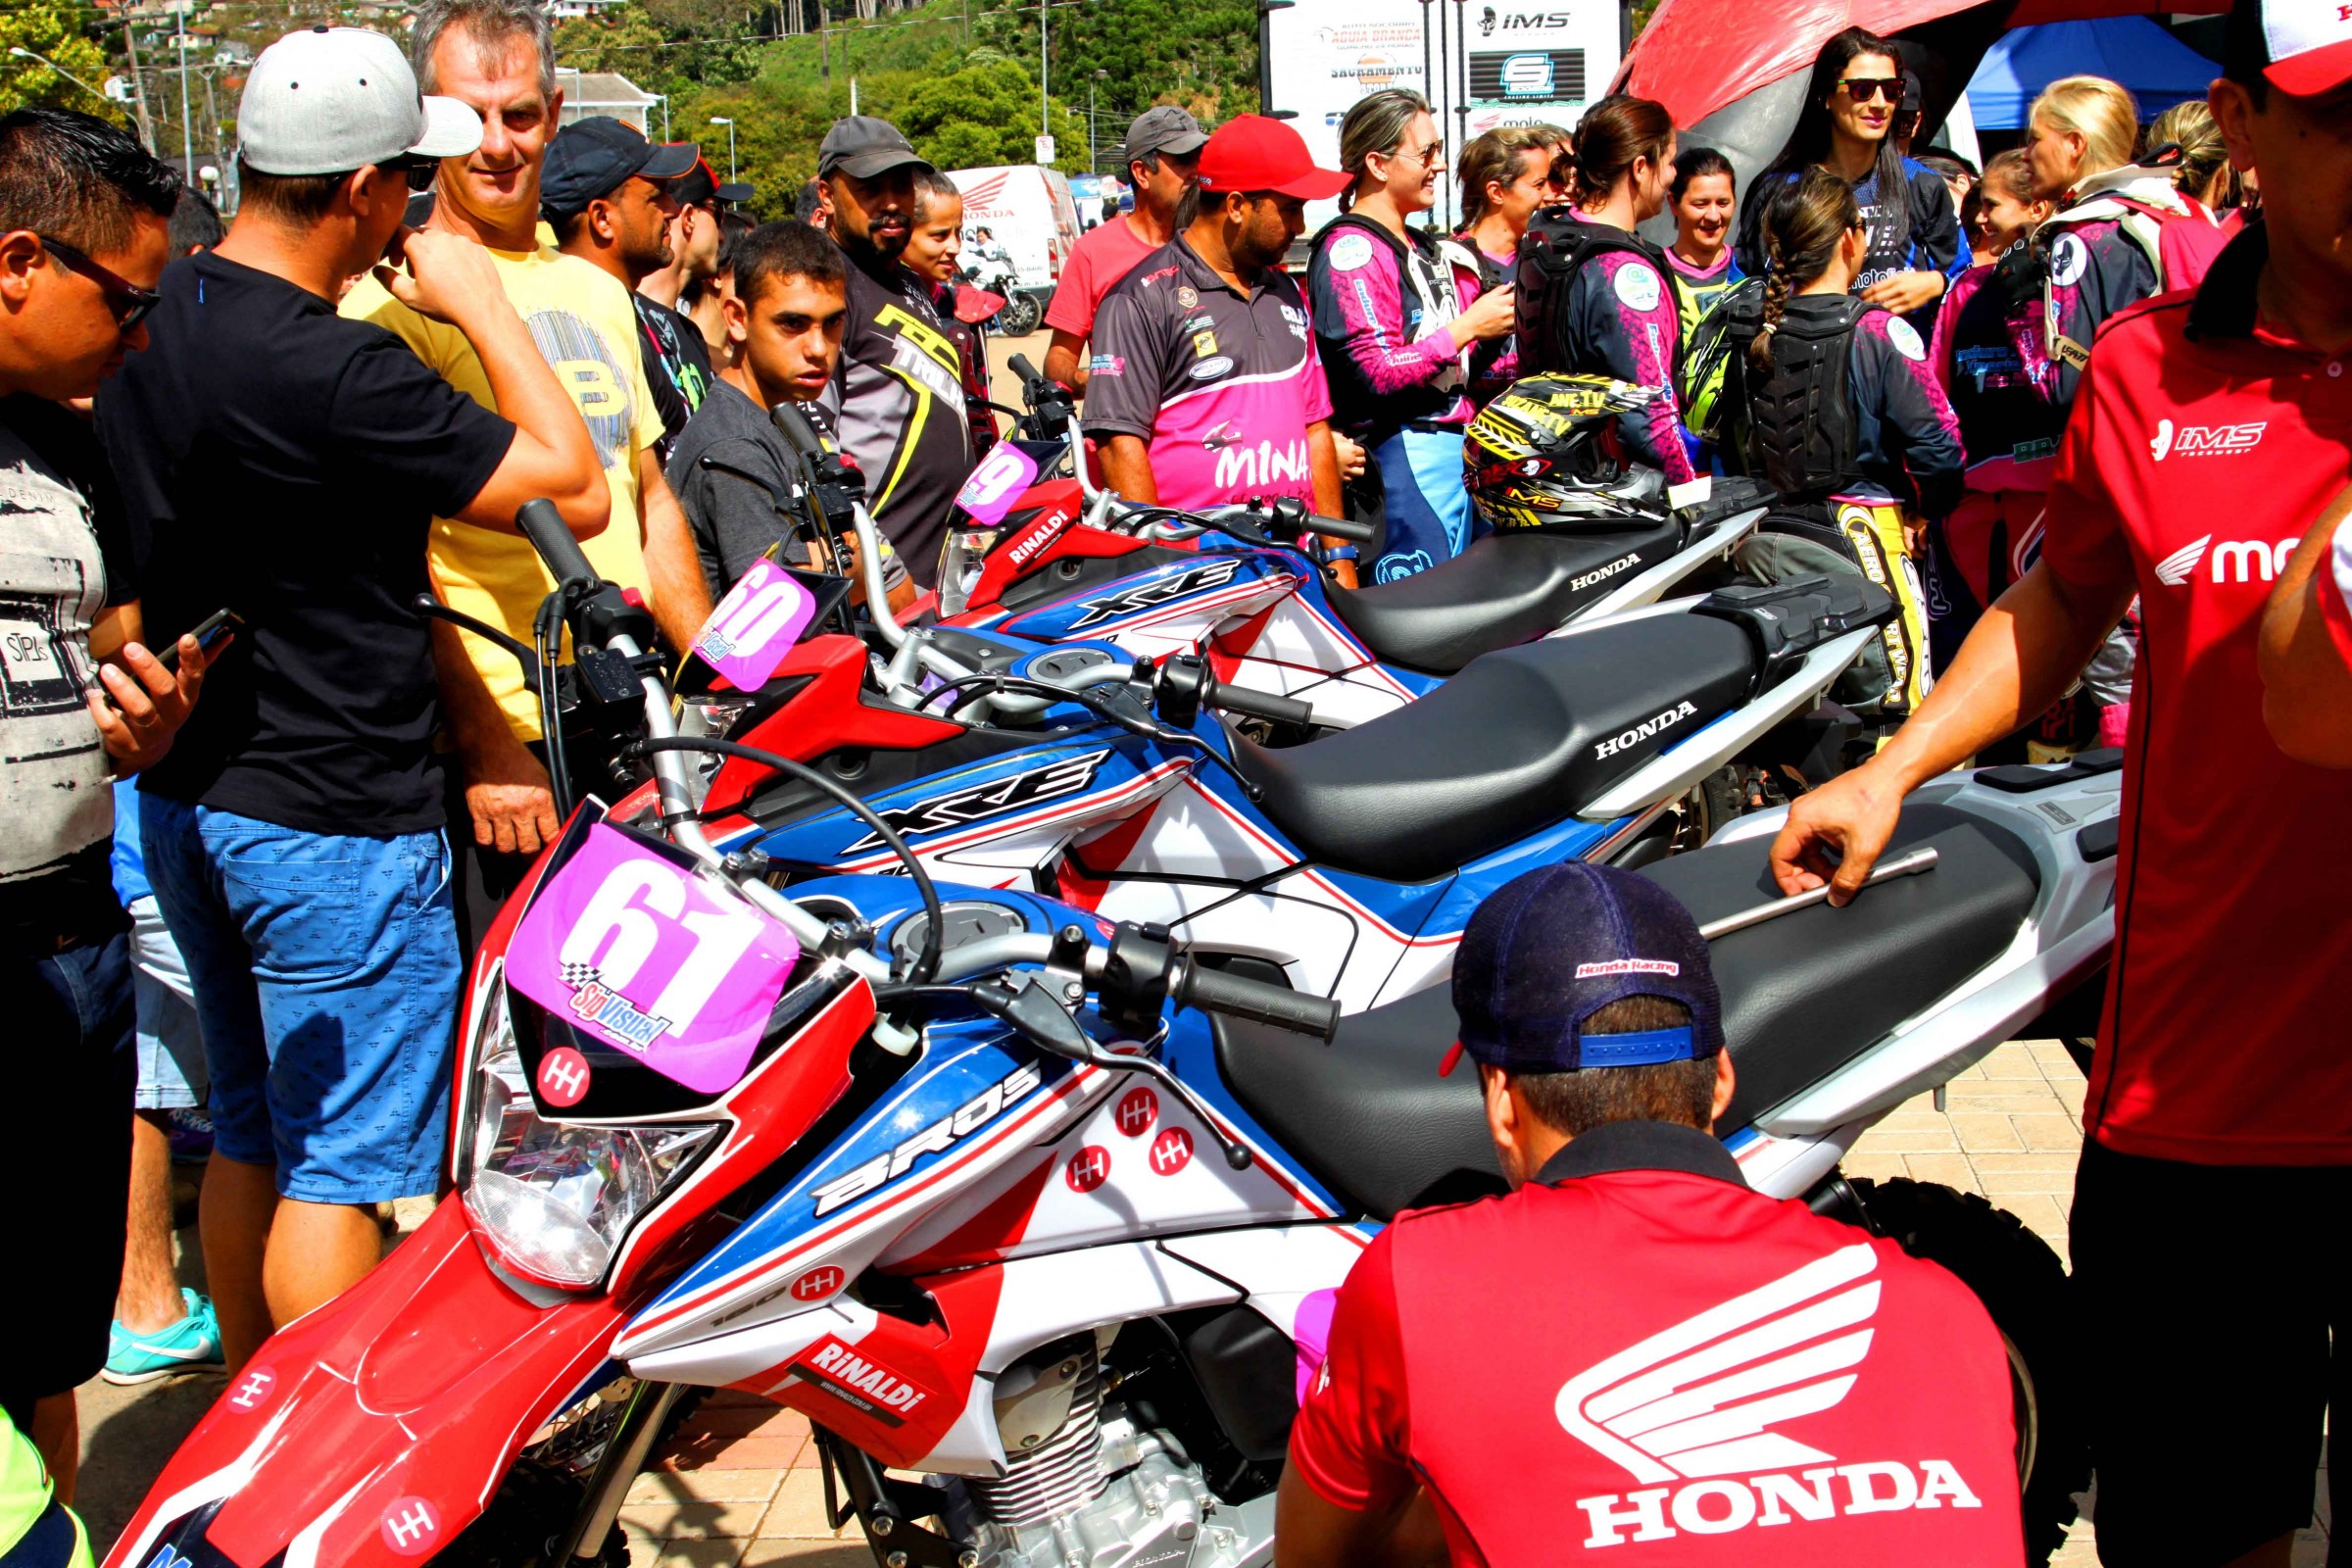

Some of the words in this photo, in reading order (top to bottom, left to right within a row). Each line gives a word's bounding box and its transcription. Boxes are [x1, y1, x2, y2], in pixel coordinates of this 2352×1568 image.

[1371, 28, 1421, 41] BRANCA
[1331, 66, 1422, 78] SACRAMENTO
[1215, 439, 1312, 489] MINA
[9, 488, 55, 504] DENIM
[1571, 553, 1642, 592] HONDA
[1849, 527, 1886, 584] AERO
[1594, 701, 1698, 761] HONDA
[560, 858, 766, 1039] 61
[1576, 959, 1628, 978] Honda
[1631, 958, 1680, 976] Racing
[809, 1061, 1043, 1218] BROS
[1576, 1459, 1982, 1549] HONDA
